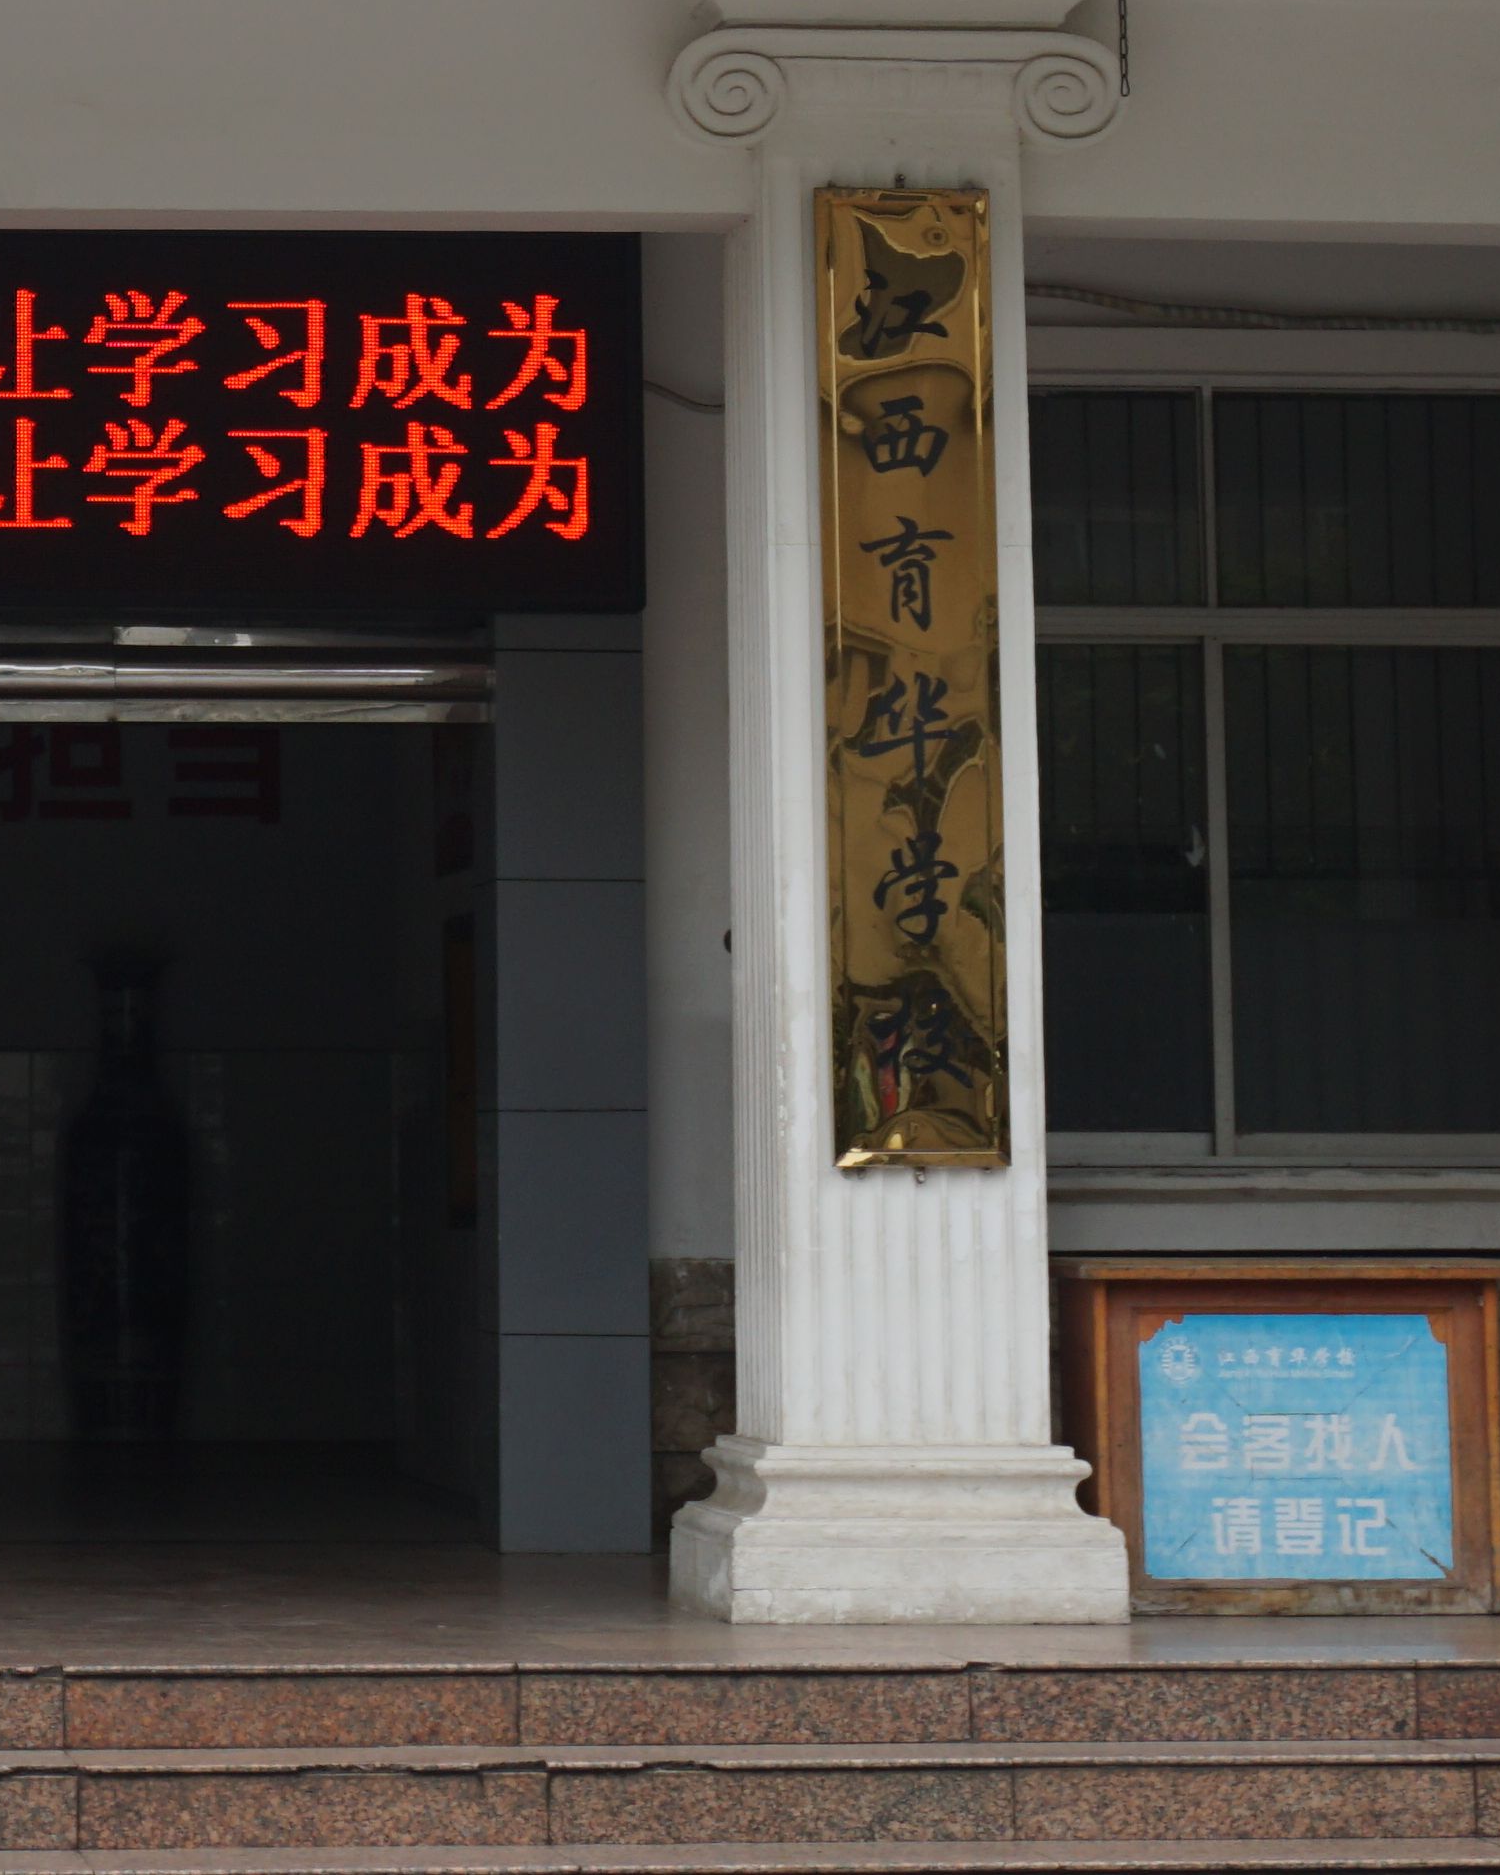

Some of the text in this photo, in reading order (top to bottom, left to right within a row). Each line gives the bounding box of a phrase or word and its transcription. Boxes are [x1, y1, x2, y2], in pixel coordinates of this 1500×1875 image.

[854, 268, 974, 1089] 江西育华学校
[1178, 1411, 1421, 1472] 会客找人
[1211, 1497, 1388, 1556] 请登记
